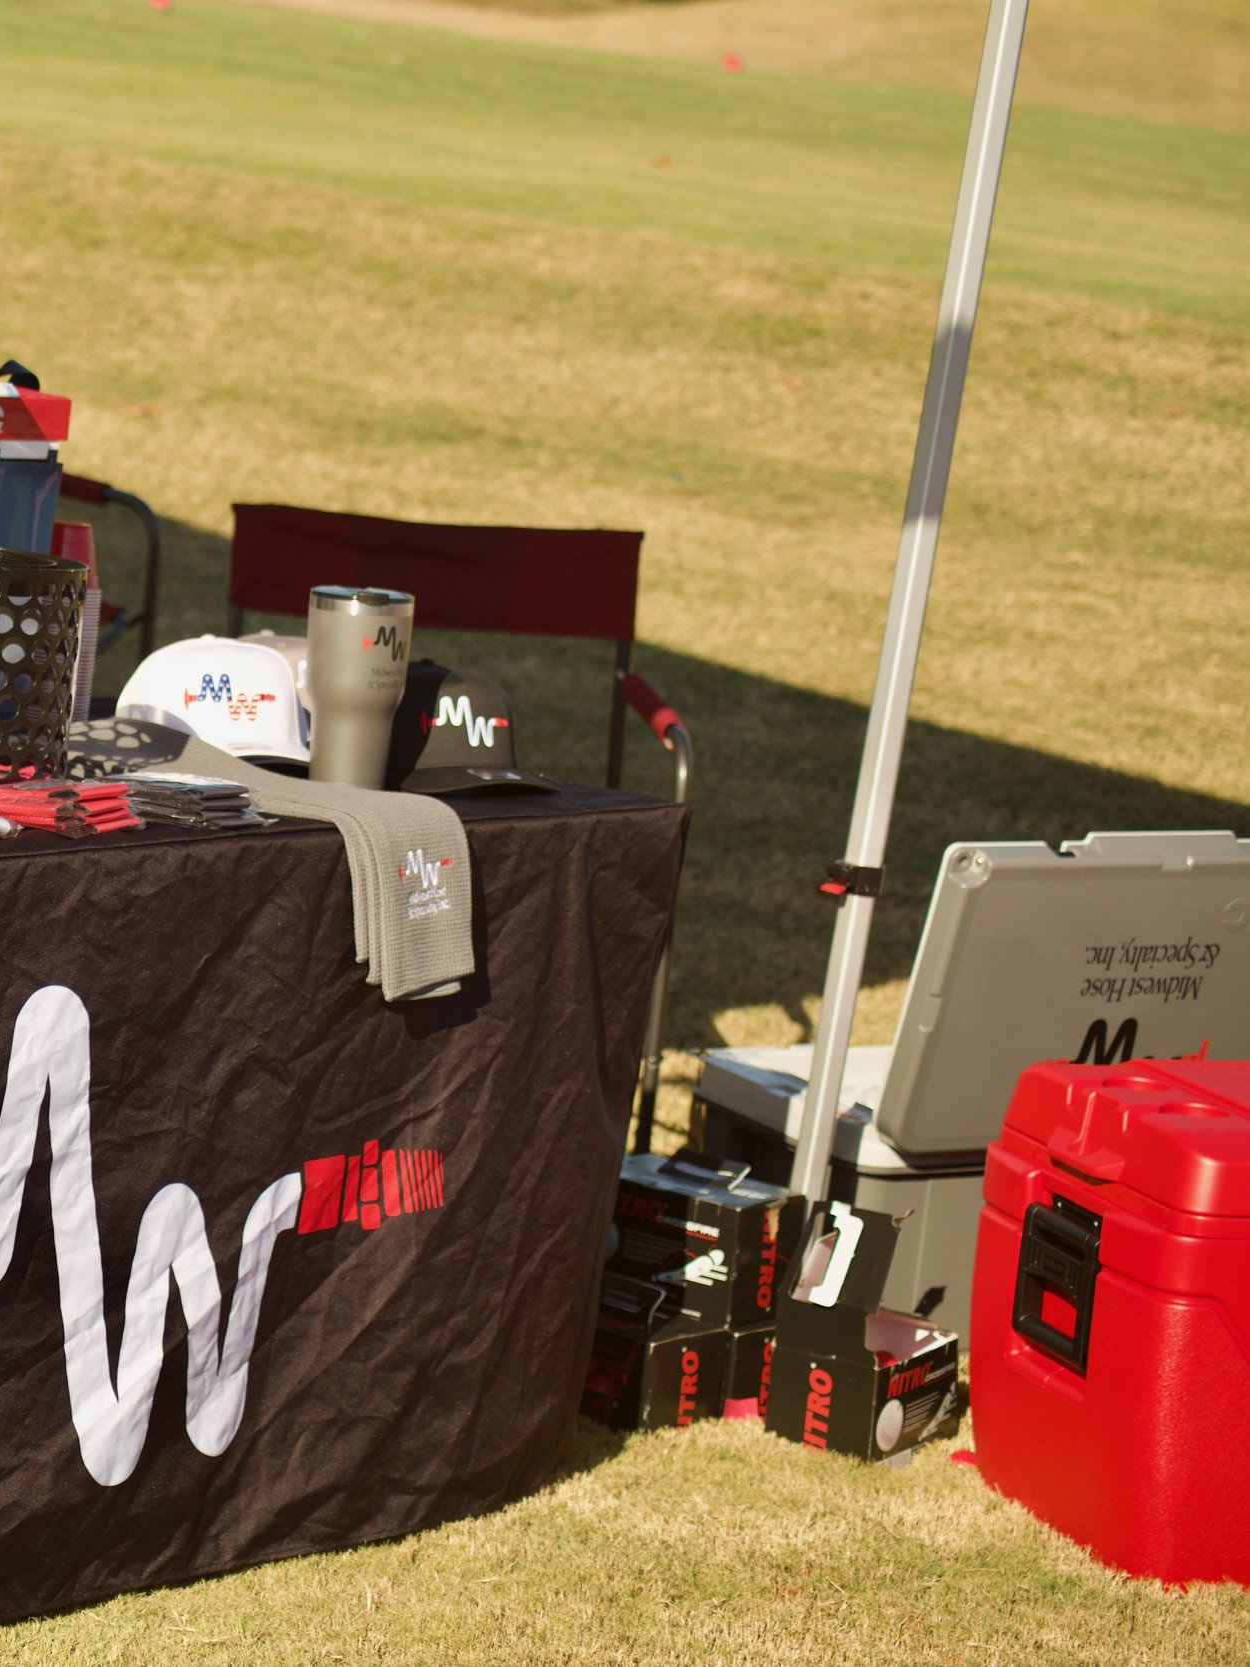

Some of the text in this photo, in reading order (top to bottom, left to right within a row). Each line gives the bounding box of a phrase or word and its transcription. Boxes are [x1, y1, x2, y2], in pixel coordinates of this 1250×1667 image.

[1085, 935, 1221, 973] & Specialty, Inc.
[1079, 974, 1203, 1004] Midwest Hose
[676, 1350, 700, 1430] ITRO
[886, 1361, 932, 1400] NITRO
[803, 1368, 833, 1453] ITRO
